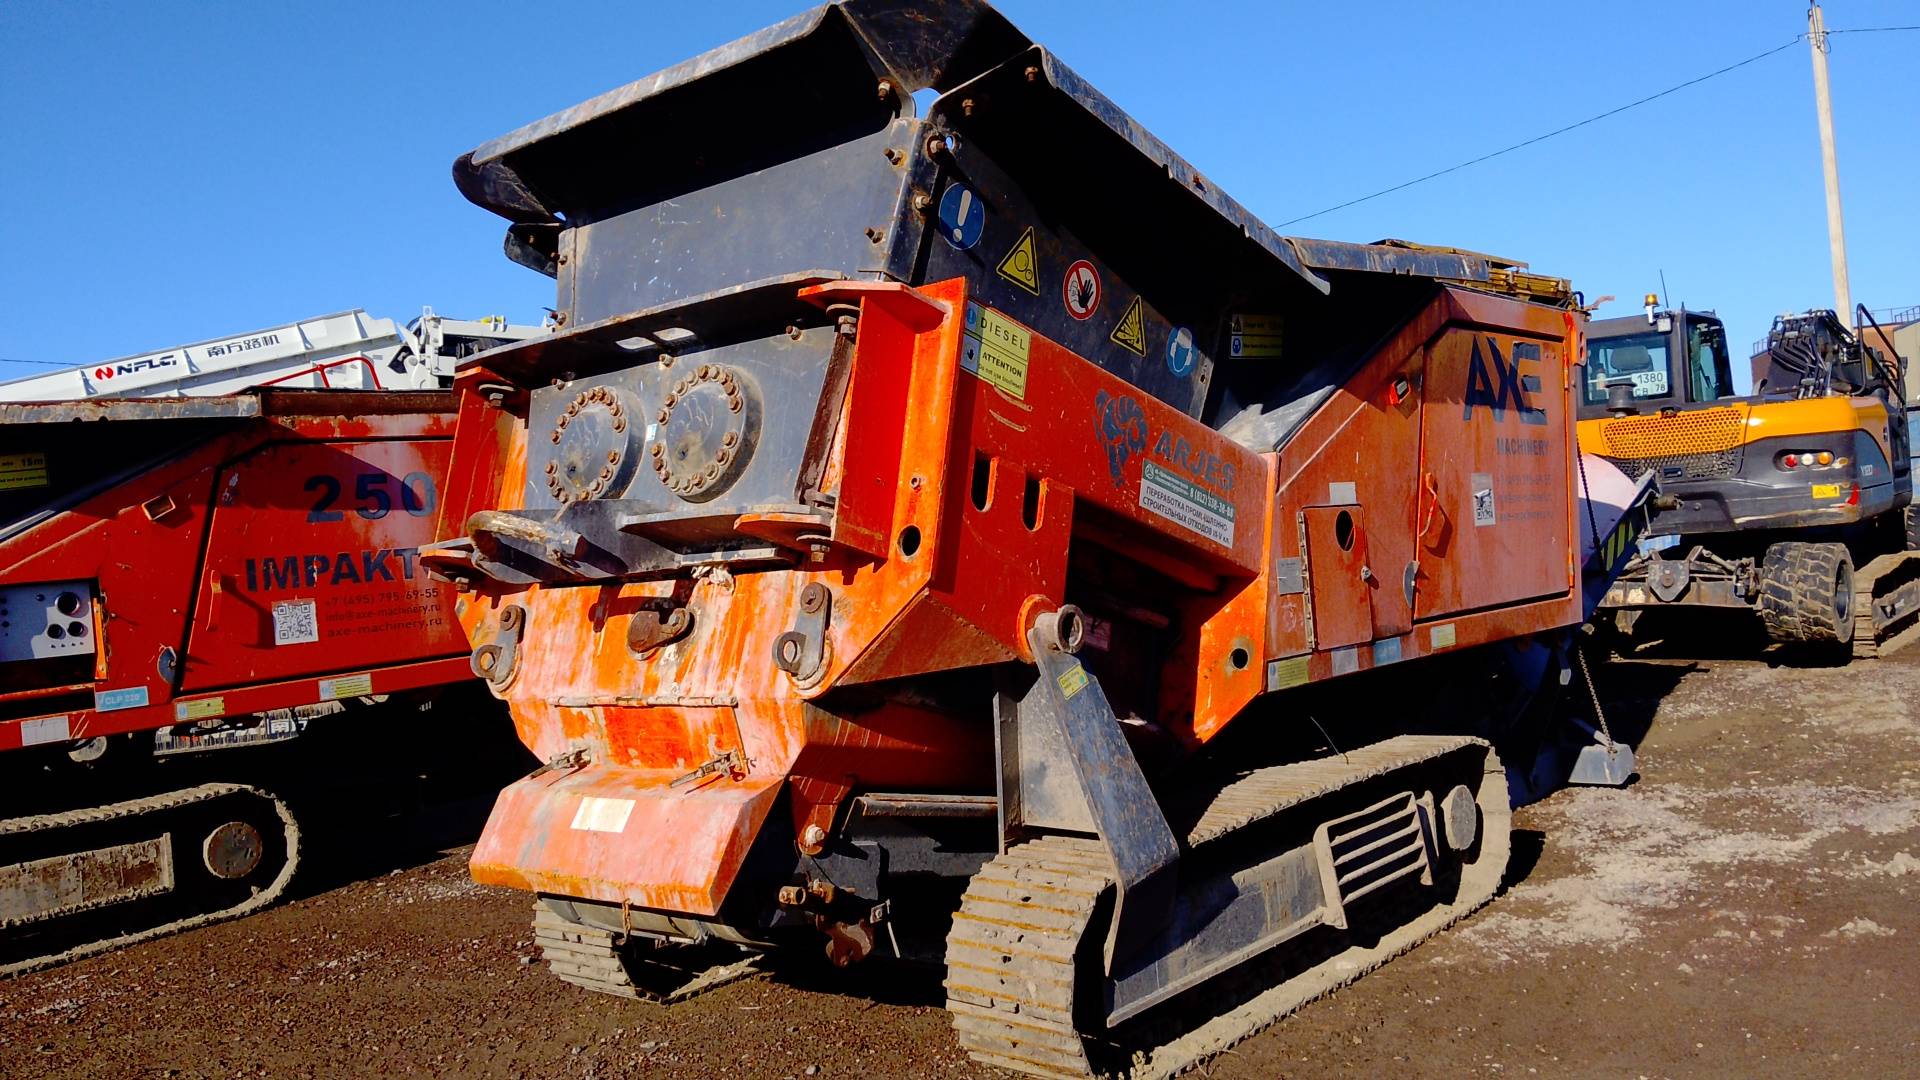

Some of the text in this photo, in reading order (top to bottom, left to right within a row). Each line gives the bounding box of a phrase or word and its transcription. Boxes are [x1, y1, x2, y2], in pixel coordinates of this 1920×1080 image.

[207, 333, 280, 358] 南方路机
[980, 316, 1025, 351] DIESEL
[982, 352, 1022, 378] ATTENTION
[1637, 372, 1664, 384] 1380
[1463, 334, 1548, 426] AXE
[1496, 436, 1549, 457] MACHINERY
[1154, 430, 1235, 491] ARJES
[303, 471, 437, 523] 250
[1146, 485, 1185, 512] ПЕРЕРАБОТКА
[1142, 496, 1187, 523] СТРОИТЕЛЬНЫХ
[1187, 514, 1212, 536] ОТХОДОВ
[245, 548, 430, 593] IMPAKT
[378, 587, 439, 602] 795-69-55
[327, 617, 442, 638] axe-machinery.ru
